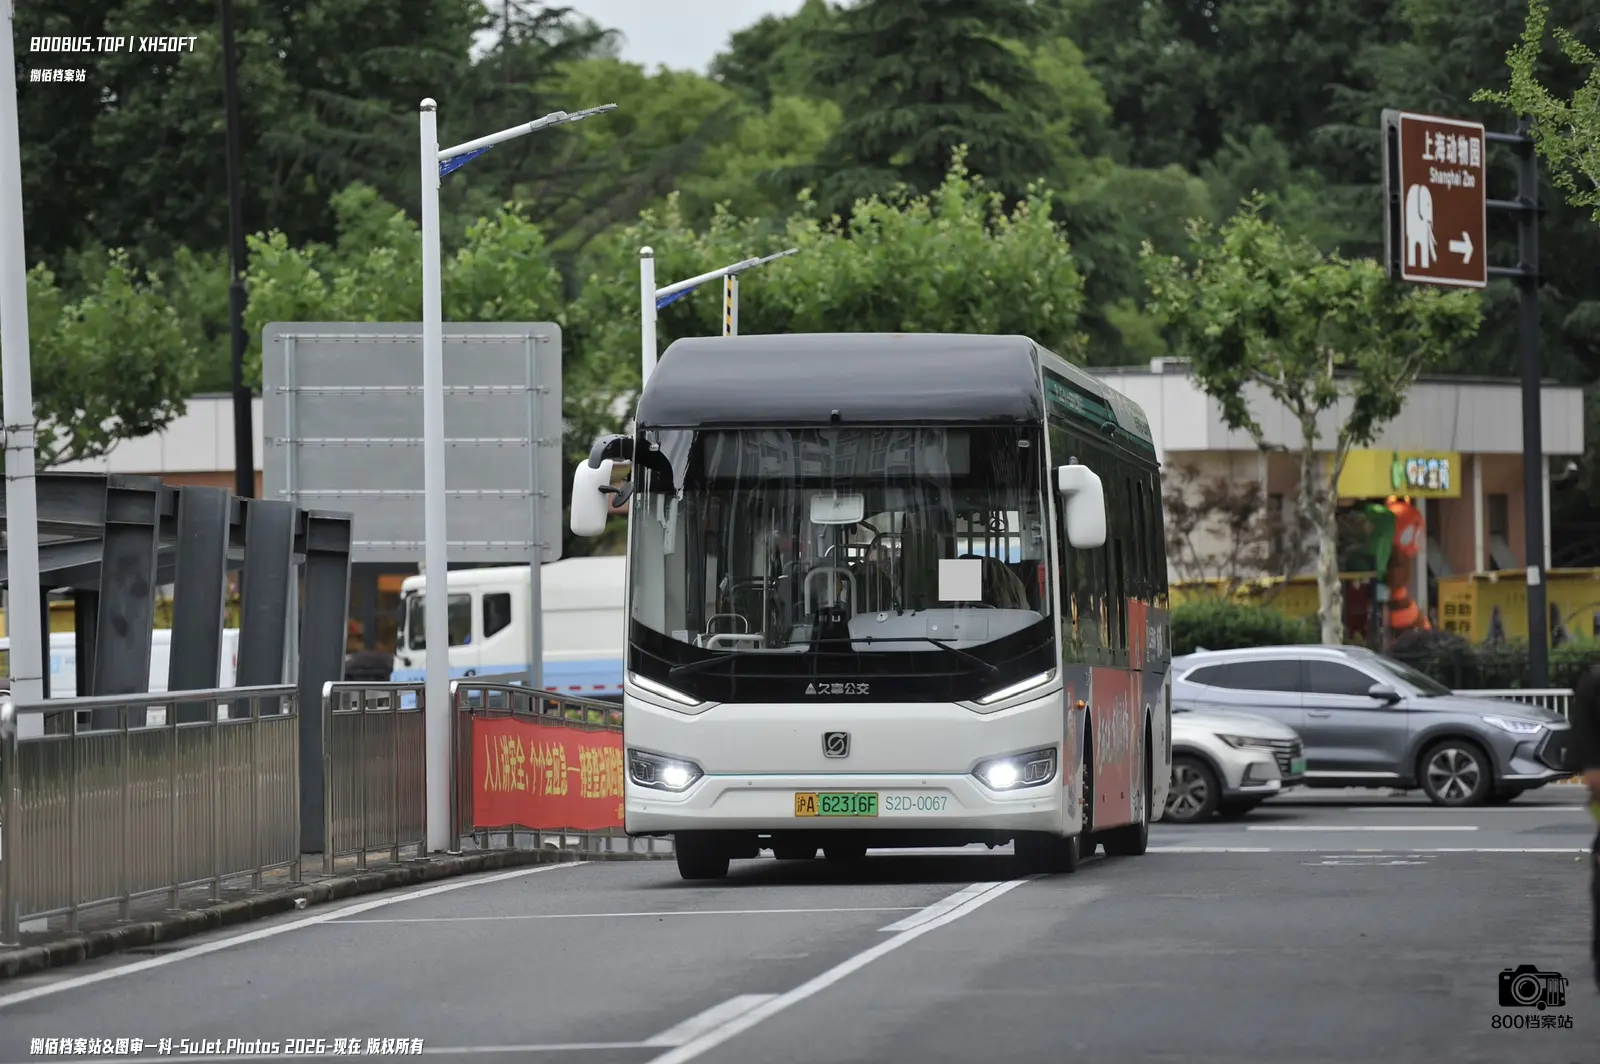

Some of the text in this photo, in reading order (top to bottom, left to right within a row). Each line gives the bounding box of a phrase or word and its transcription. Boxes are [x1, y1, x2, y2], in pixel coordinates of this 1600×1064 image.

[1422, 130, 1481, 168] 上海动物园
[1429, 166, 1476, 191] Shanghai Zoo
[885, 796, 948, 811] S2D-0067
